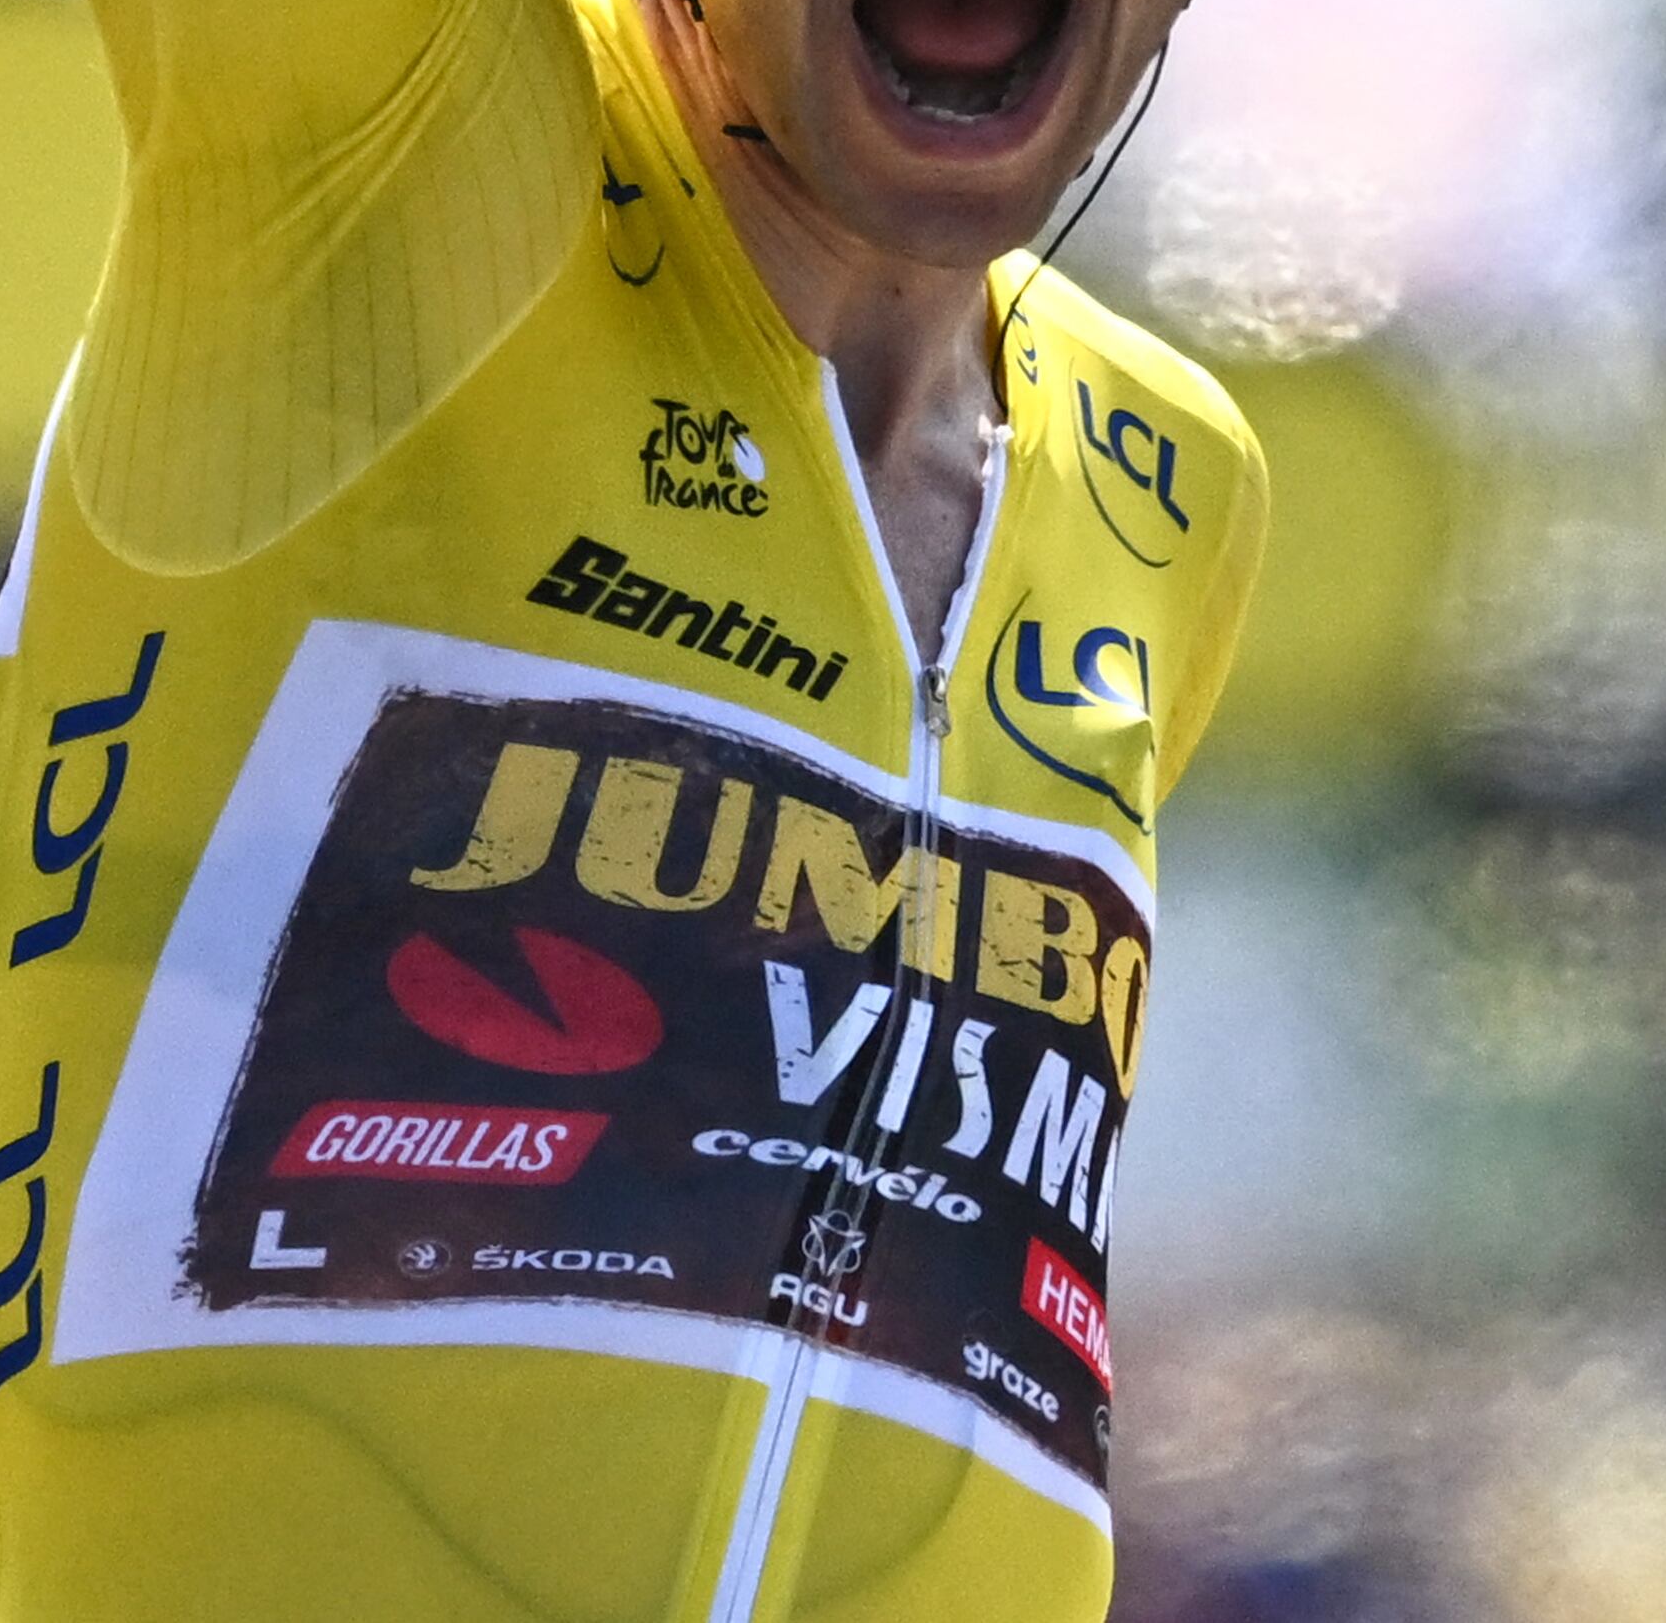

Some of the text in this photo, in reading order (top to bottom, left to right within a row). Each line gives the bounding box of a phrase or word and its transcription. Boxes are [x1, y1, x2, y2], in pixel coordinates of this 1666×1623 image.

[1076, 379, 1190, 535] LCL
[525, 535, 848, 702] Santini
[9, 631, 166, 969] LCL
[409, 742, 1148, 1100] JUMBO
[306, 1114, 568, 1171] GORILLAS
[691, 1128, 982, 1223] cervélo
[249, 1210, 327, 1269] L
[472, 1244, 675, 1279] ŠKODA
[770, 1273, 869, 1327] AGU
[963, 1340, 1061, 1422] graze
